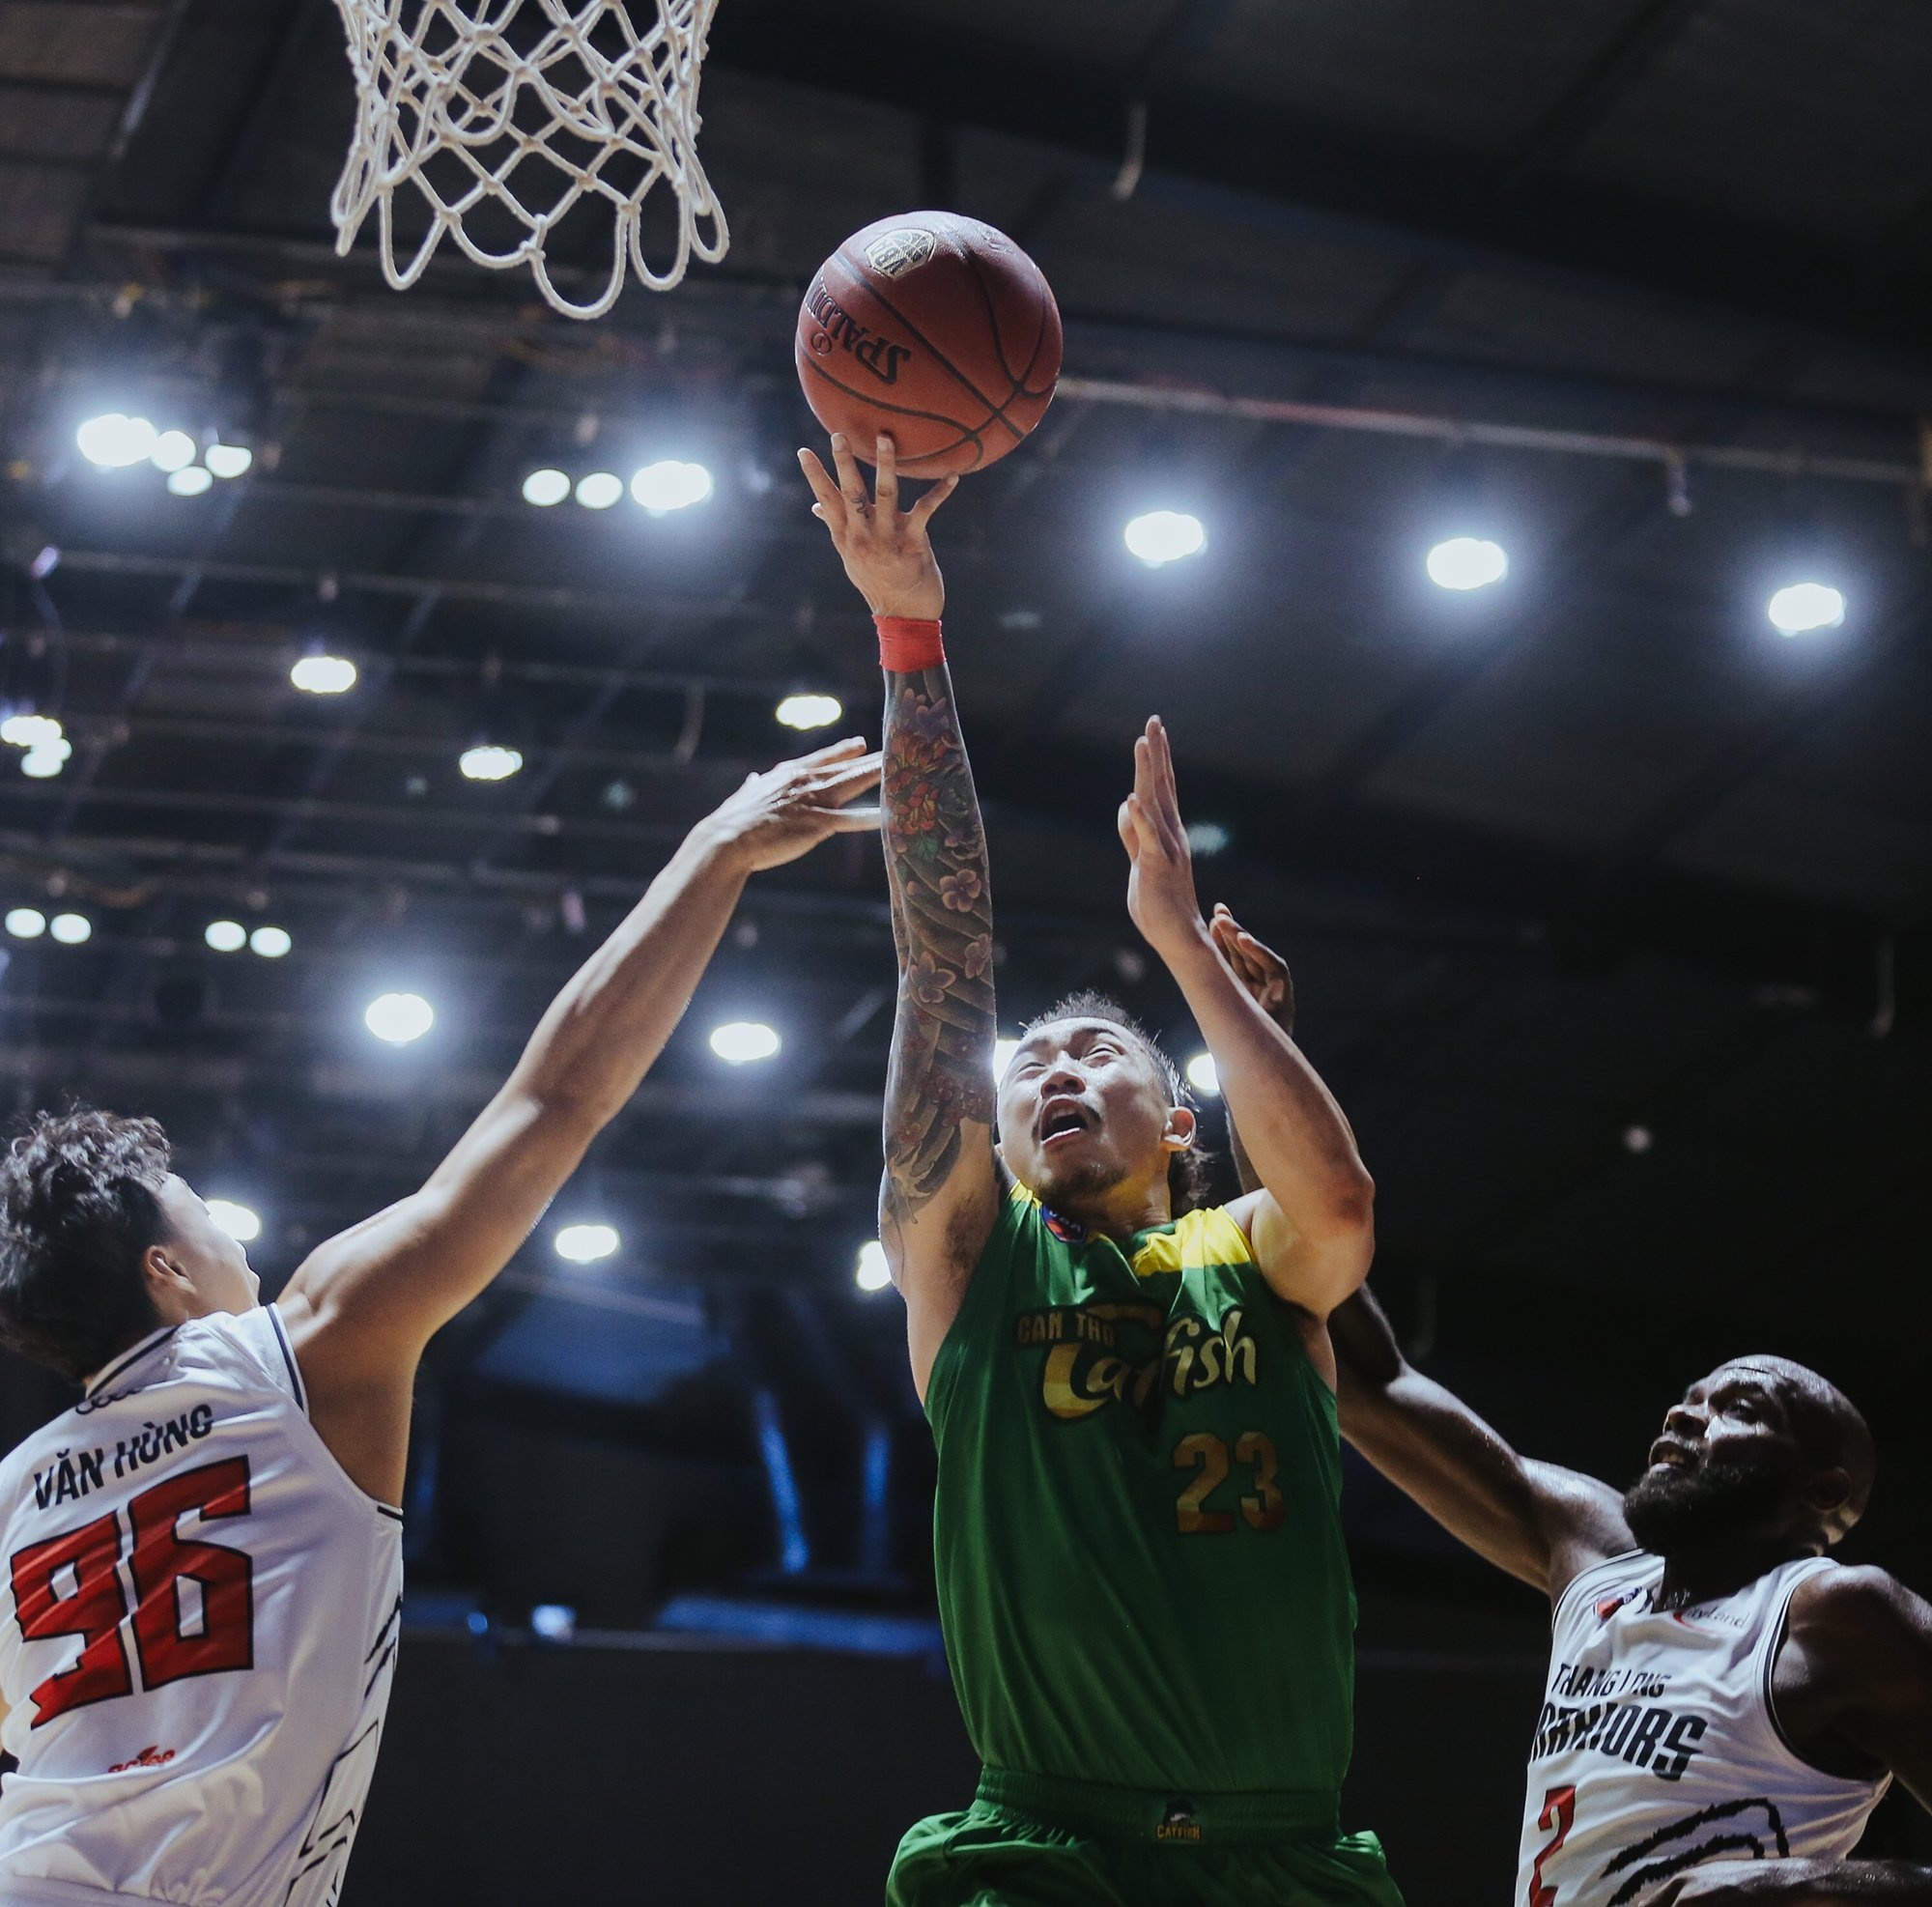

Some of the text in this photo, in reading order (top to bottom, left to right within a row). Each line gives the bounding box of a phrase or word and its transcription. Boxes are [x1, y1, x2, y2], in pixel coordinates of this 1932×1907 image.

[805, 276, 912, 384] SPALDI
[1017, 1311, 1064, 1344] CAN
[33, 1404, 213, 1510] VĂN HÙNG
[1173, 1430, 1287, 1534] 23
[10, 1454, 254, 1730] 96
[1530, 1701, 1708, 1781] ARRIORS
[1528, 1784, 1577, 1907] 2
